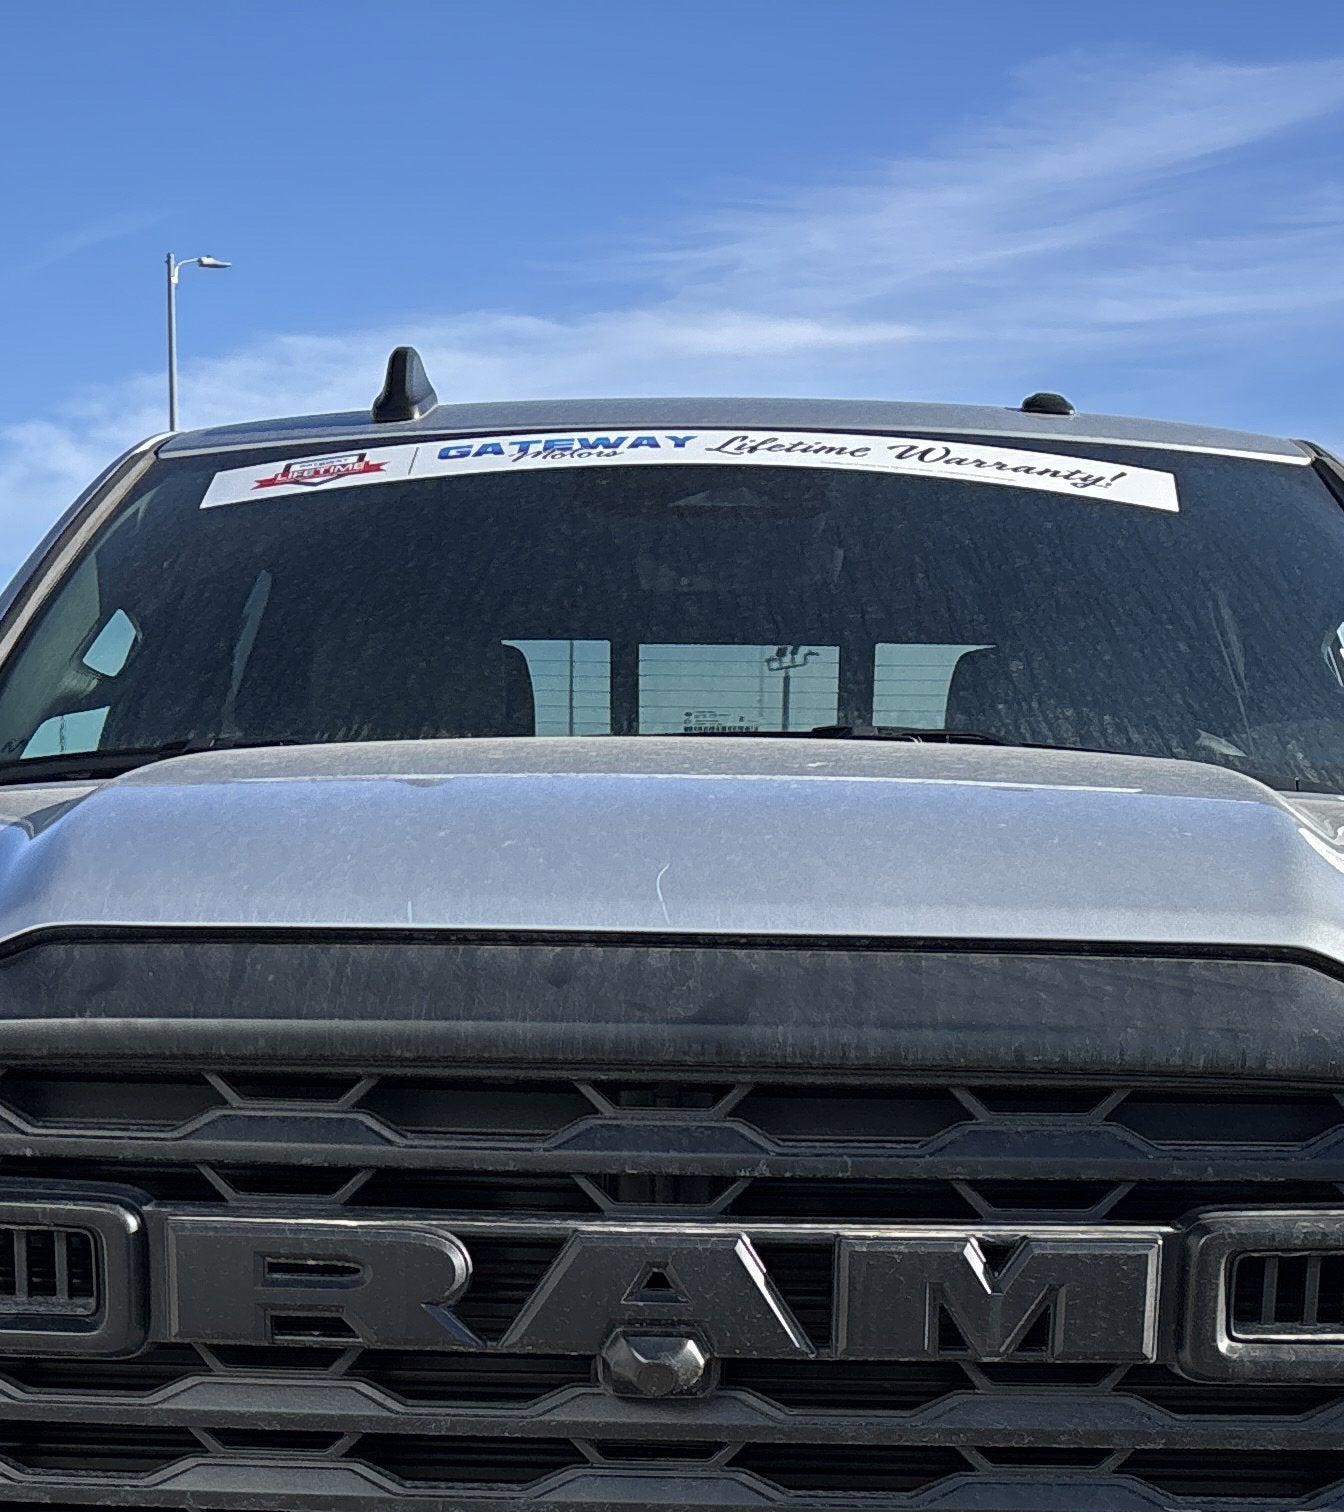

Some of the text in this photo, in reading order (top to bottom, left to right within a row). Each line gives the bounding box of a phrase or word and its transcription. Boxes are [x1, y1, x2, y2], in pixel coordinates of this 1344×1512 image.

[275, 460, 365, 482] LIFETIME
[437, 435, 698, 460] GATEWAY
[705, 435, 872, 458] Lifetime
[886, 444, 1128, 488] Warranty!
[508, 447, 625, 463] Motors
[165, 1217, 1163, 1363] RAM
